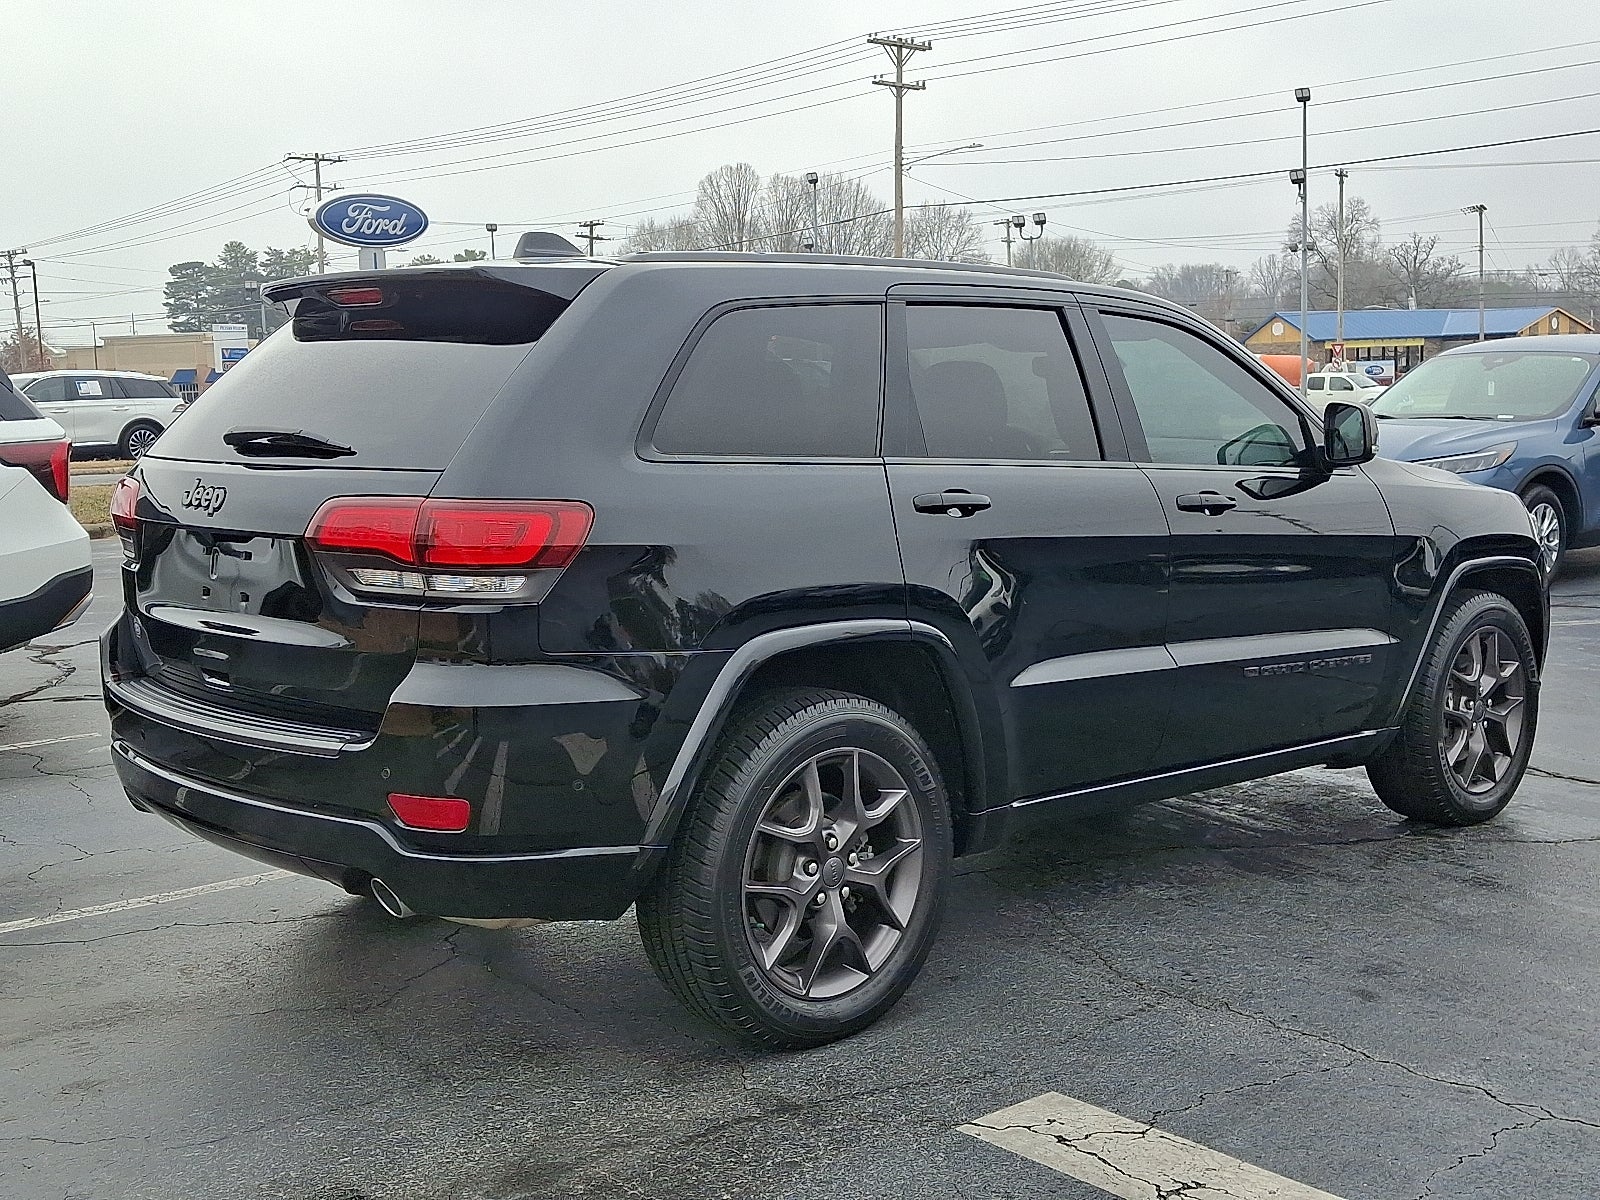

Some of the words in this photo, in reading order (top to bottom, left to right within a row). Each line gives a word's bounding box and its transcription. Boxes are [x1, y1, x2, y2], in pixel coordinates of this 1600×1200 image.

[341, 202, 407, 235] Ford
[182, 477, 228, 517] Jeep
[741, 966, 810, 1022] ICHELIN
